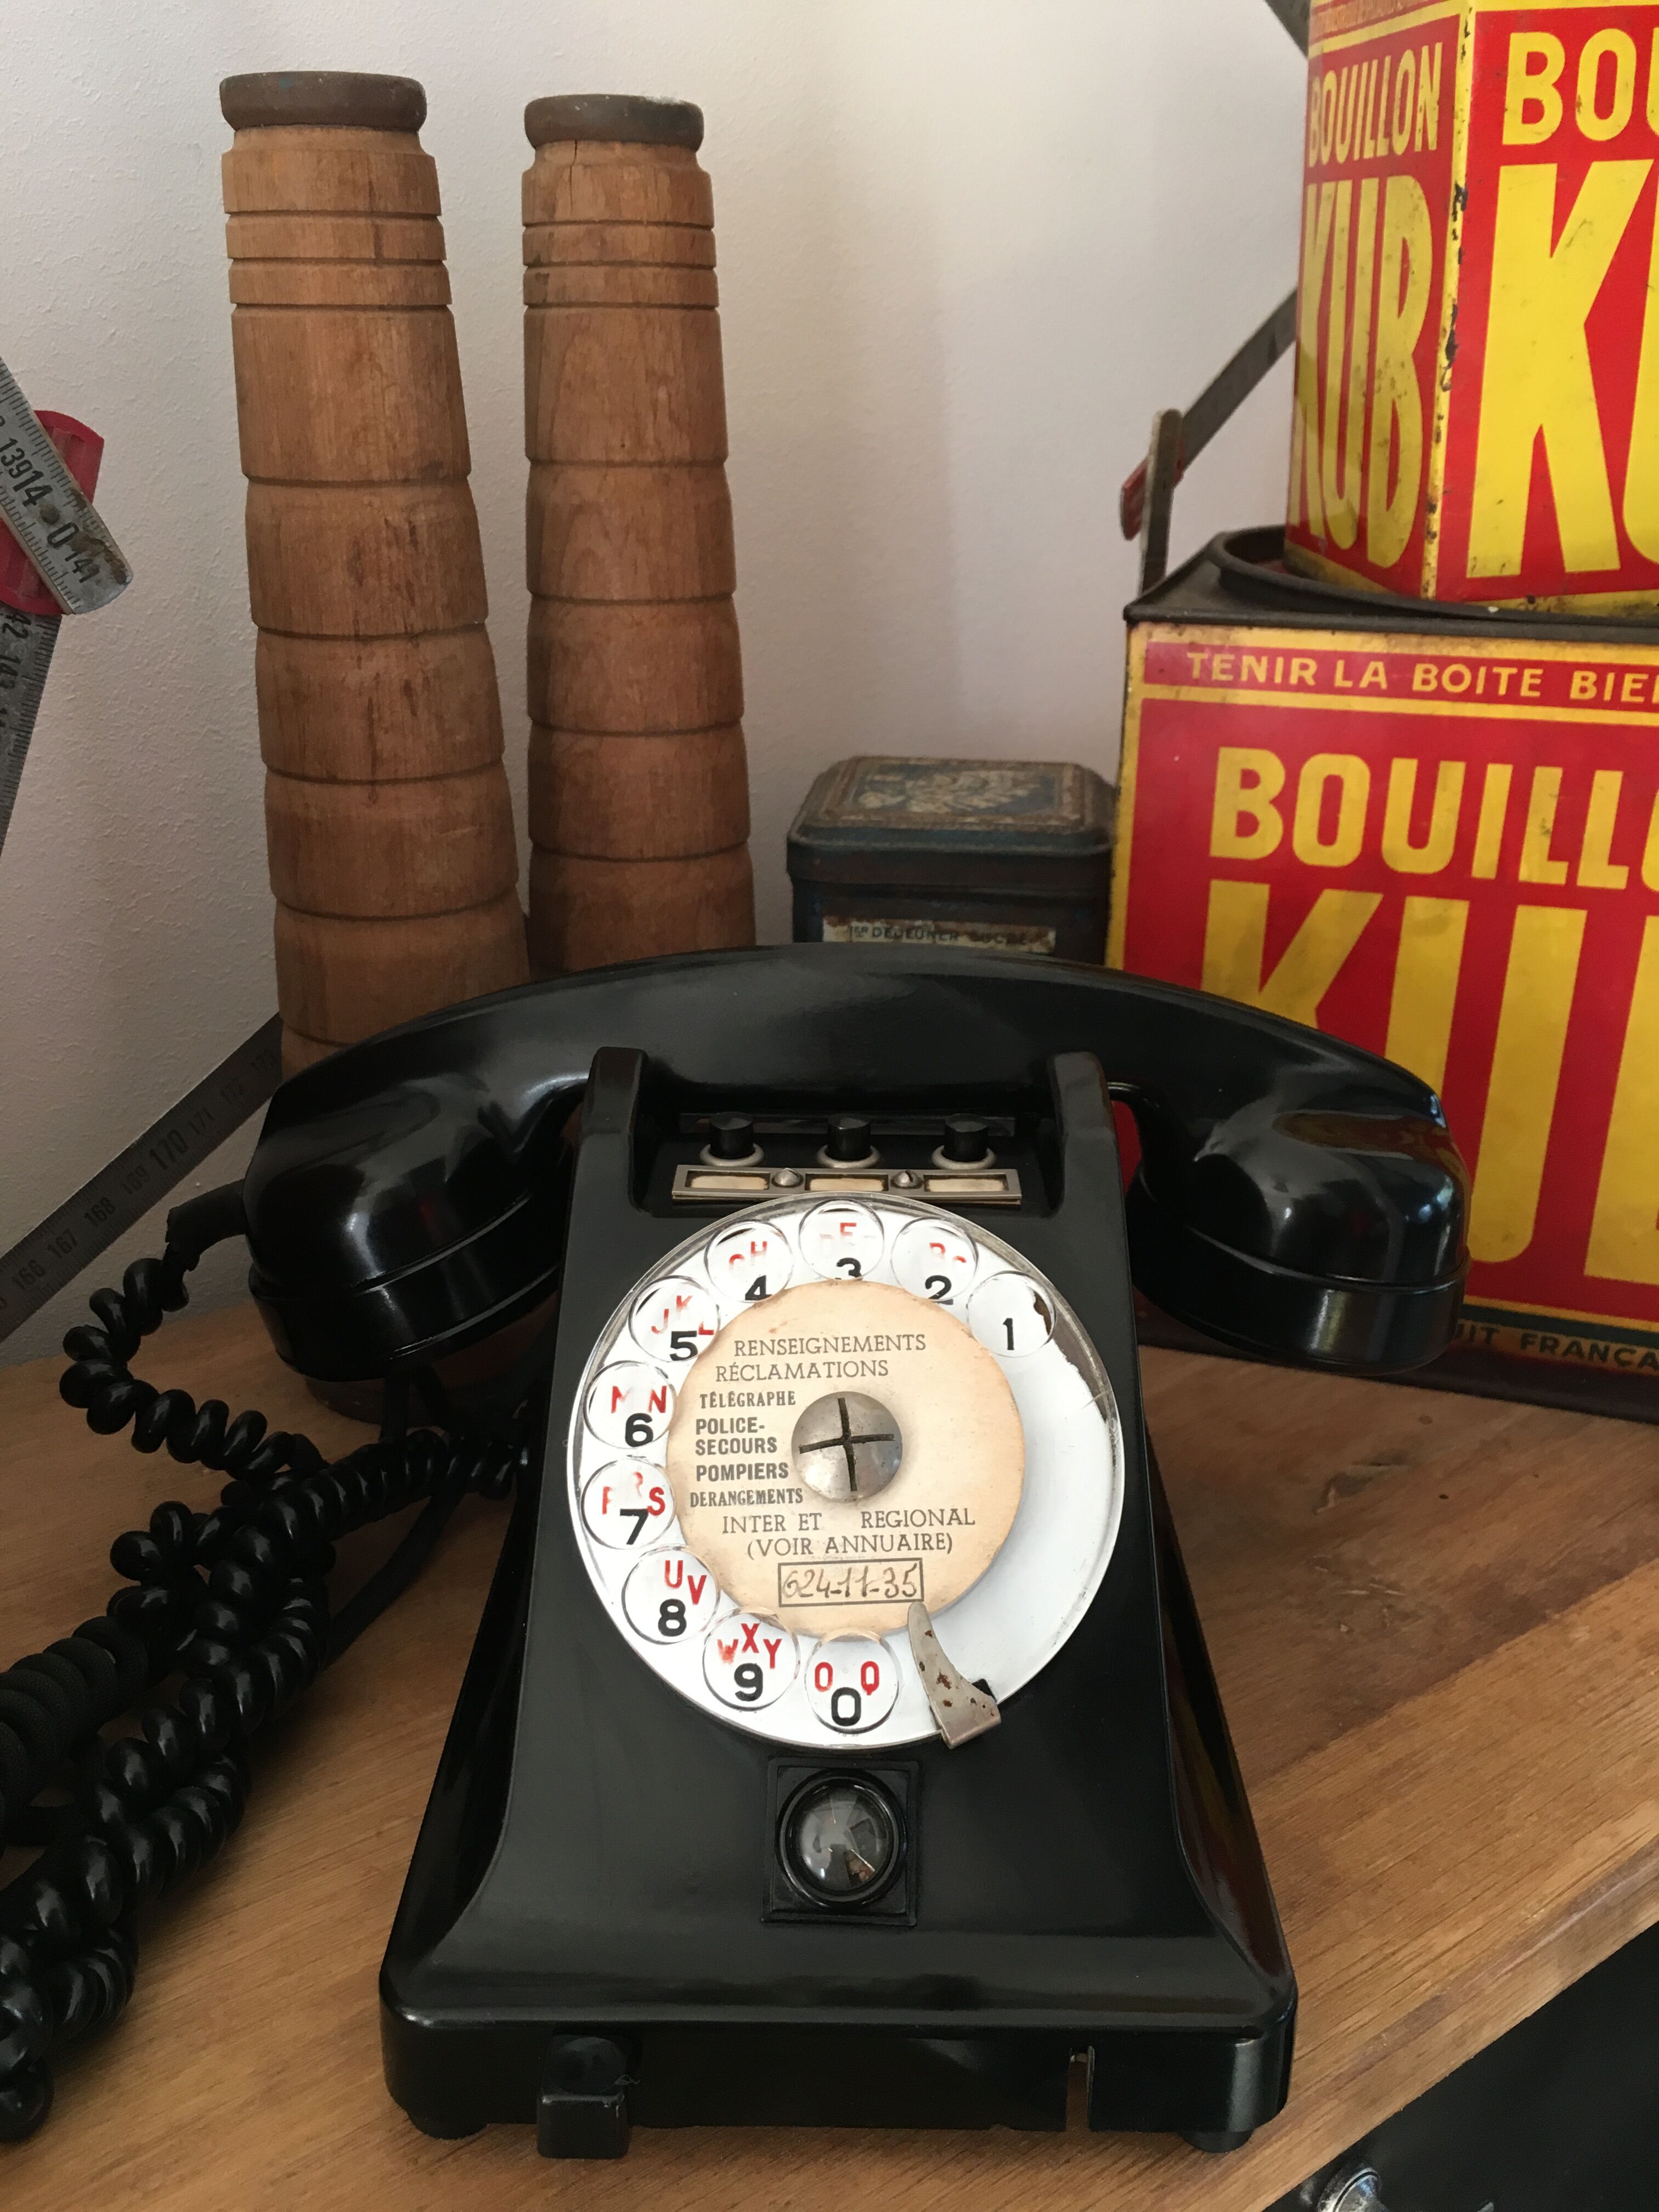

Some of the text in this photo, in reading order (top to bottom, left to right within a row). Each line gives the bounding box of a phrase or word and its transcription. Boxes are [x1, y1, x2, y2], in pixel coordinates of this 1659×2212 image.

[1503, 27, 1659, 145] BO
[1309, 42, 1443, 167] BOUILLON
[1287, 174, 1433, 569] KUB
[1187, 652, 1659, 703] TENIR LA BOITE BIE
[1210, 746, 1659, 892] BOUILL
[744, 1275, 772, 1301] 4
[925, 1275, 953, 1305] 2
[670, 1330, 698, 1361] 5
[735, 1334, 926, 1357] RENSEIGNEMENTS
[1003, 1318, 1015, 1350] 1
[716, 1360, 888, 1382] RÉCLAMATIONS
[625, 1412, 653, 1448] 6
[696, 1417, 765, 1435] POLICE-
[695, 1437, 777, 1455] SECOURS
[697, 1462, 789, 1481] POMPIERS
[690, 1488, 803, 1507] DERANGEMENTS
[619, 1508, 649, 1545] 7
[723, 1508, 975, 1534] INTER ET REGIONAL
[748, 1532, 953, 1560] (VOIR ANNUAIRE)
[658, 1598, 687, 1637] 8
[733, 1662, 764, 1702] 9
